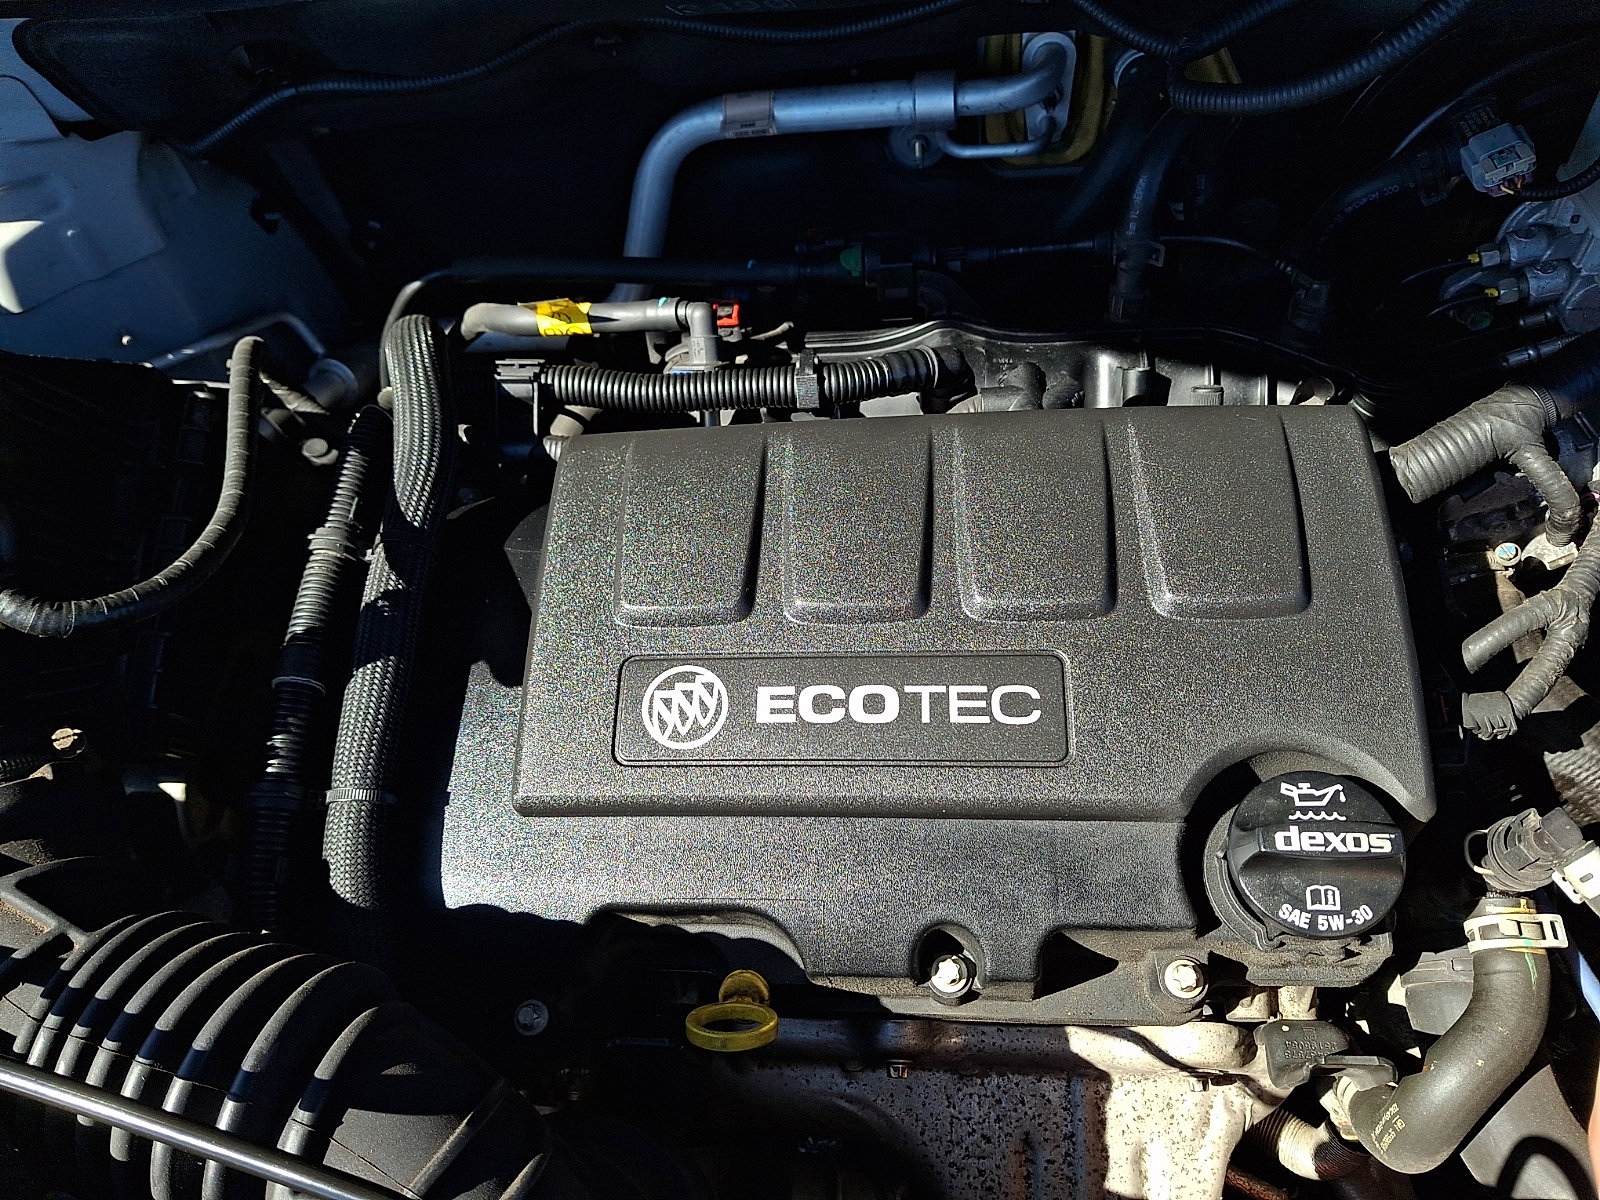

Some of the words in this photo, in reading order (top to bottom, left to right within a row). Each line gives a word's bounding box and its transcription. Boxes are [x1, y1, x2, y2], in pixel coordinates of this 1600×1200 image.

[756, 684, 1042, 725] ECOTEC
[1274, 825, 1393, 853] dexos
[1278, 903, 1311, 929] SAE
[1317, 904, 1373, 931] 5W-30
